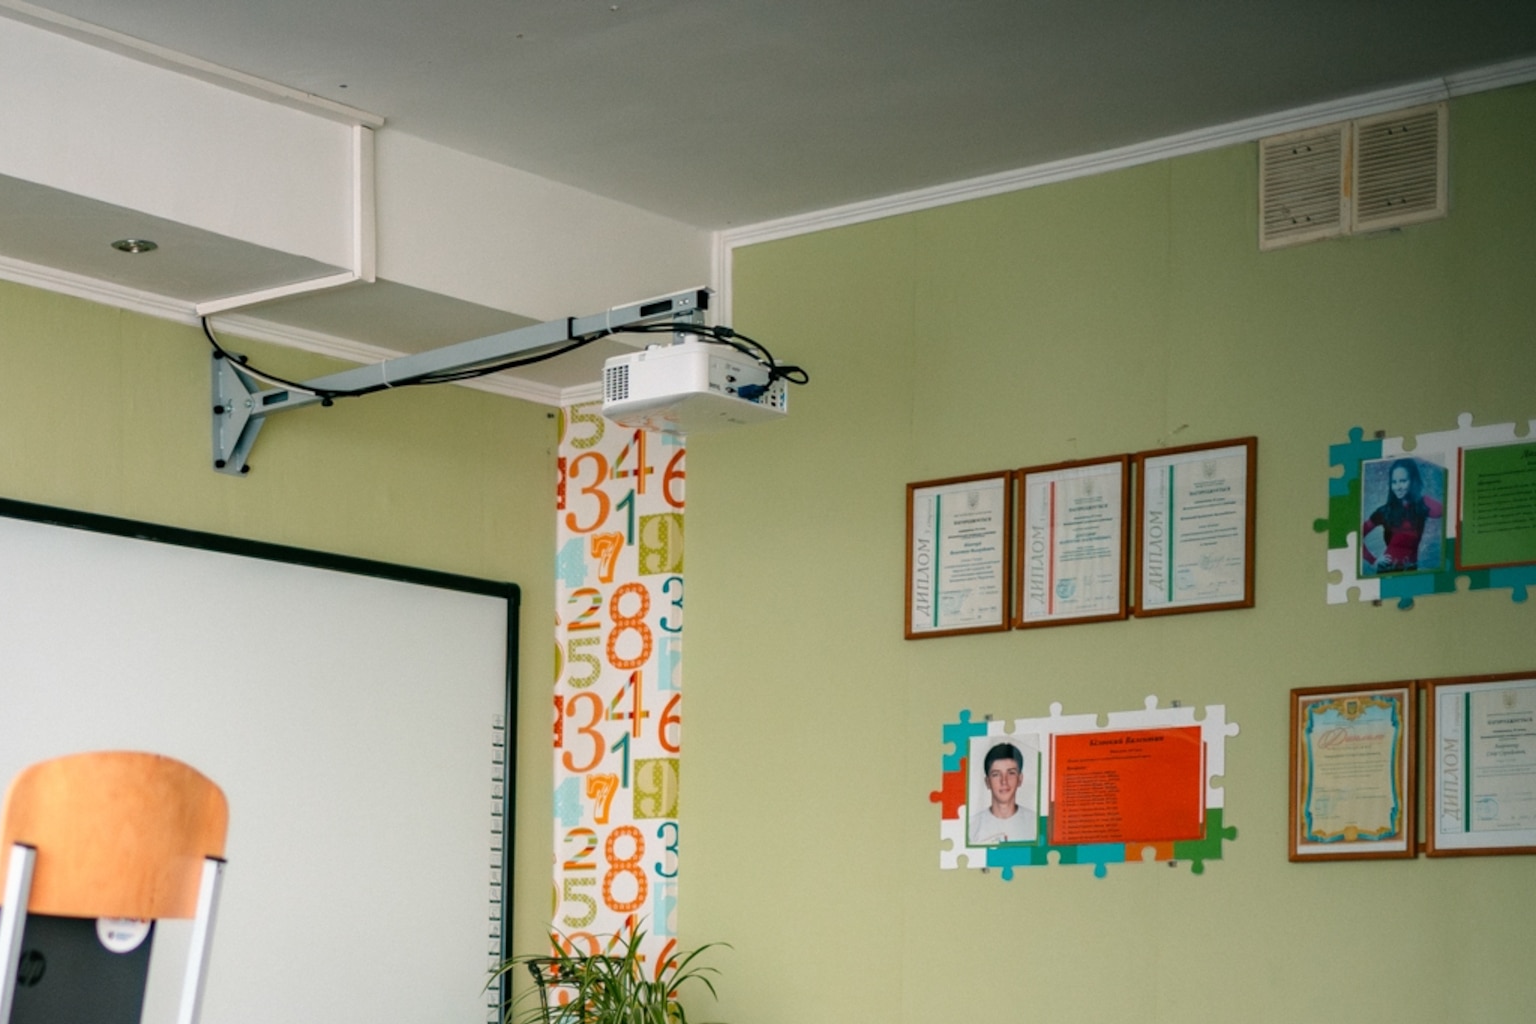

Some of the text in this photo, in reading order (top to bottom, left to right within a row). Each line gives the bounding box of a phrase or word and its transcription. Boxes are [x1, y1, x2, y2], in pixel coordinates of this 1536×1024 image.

[570, 401, 605, 449] 5
[610, 429, 654, 494] 4
[662, 449, 686, 508] 6
[565, 452, 611, 533] 3
[616, 488, 635, 545] 1
[591, 531, 624, 584] 7
[640, 514, 684, 575] 9
[1030, 525, 1045, 604] ДИПЛОМ
[1149, 510, 1164, 591] ДИПЛОМ
[659, 576, 683, 633] 3
[916, 538, 931, 617] ДИПЛОМ
[567, 588, 602, 632] 2
[606, 582, 653, 670] 8
[567, 636, 601, 689] 5
[562, 692, 606, 773] 3
[606, 670, 649, 738] 4
[658, 693, 681, 753] 6
[611, 731, 630, 789] 1
[633, 757, 680, 820] 9
[1443, 738, 1460, 821] ДИПЛОМ
[586, 773, 619, 825] 7
[563, 827, 598, 871] 2
[602, 825, 648, 913] 8
[654, 822, 679, 878] 3
[563, 877, 597, 928] 5
